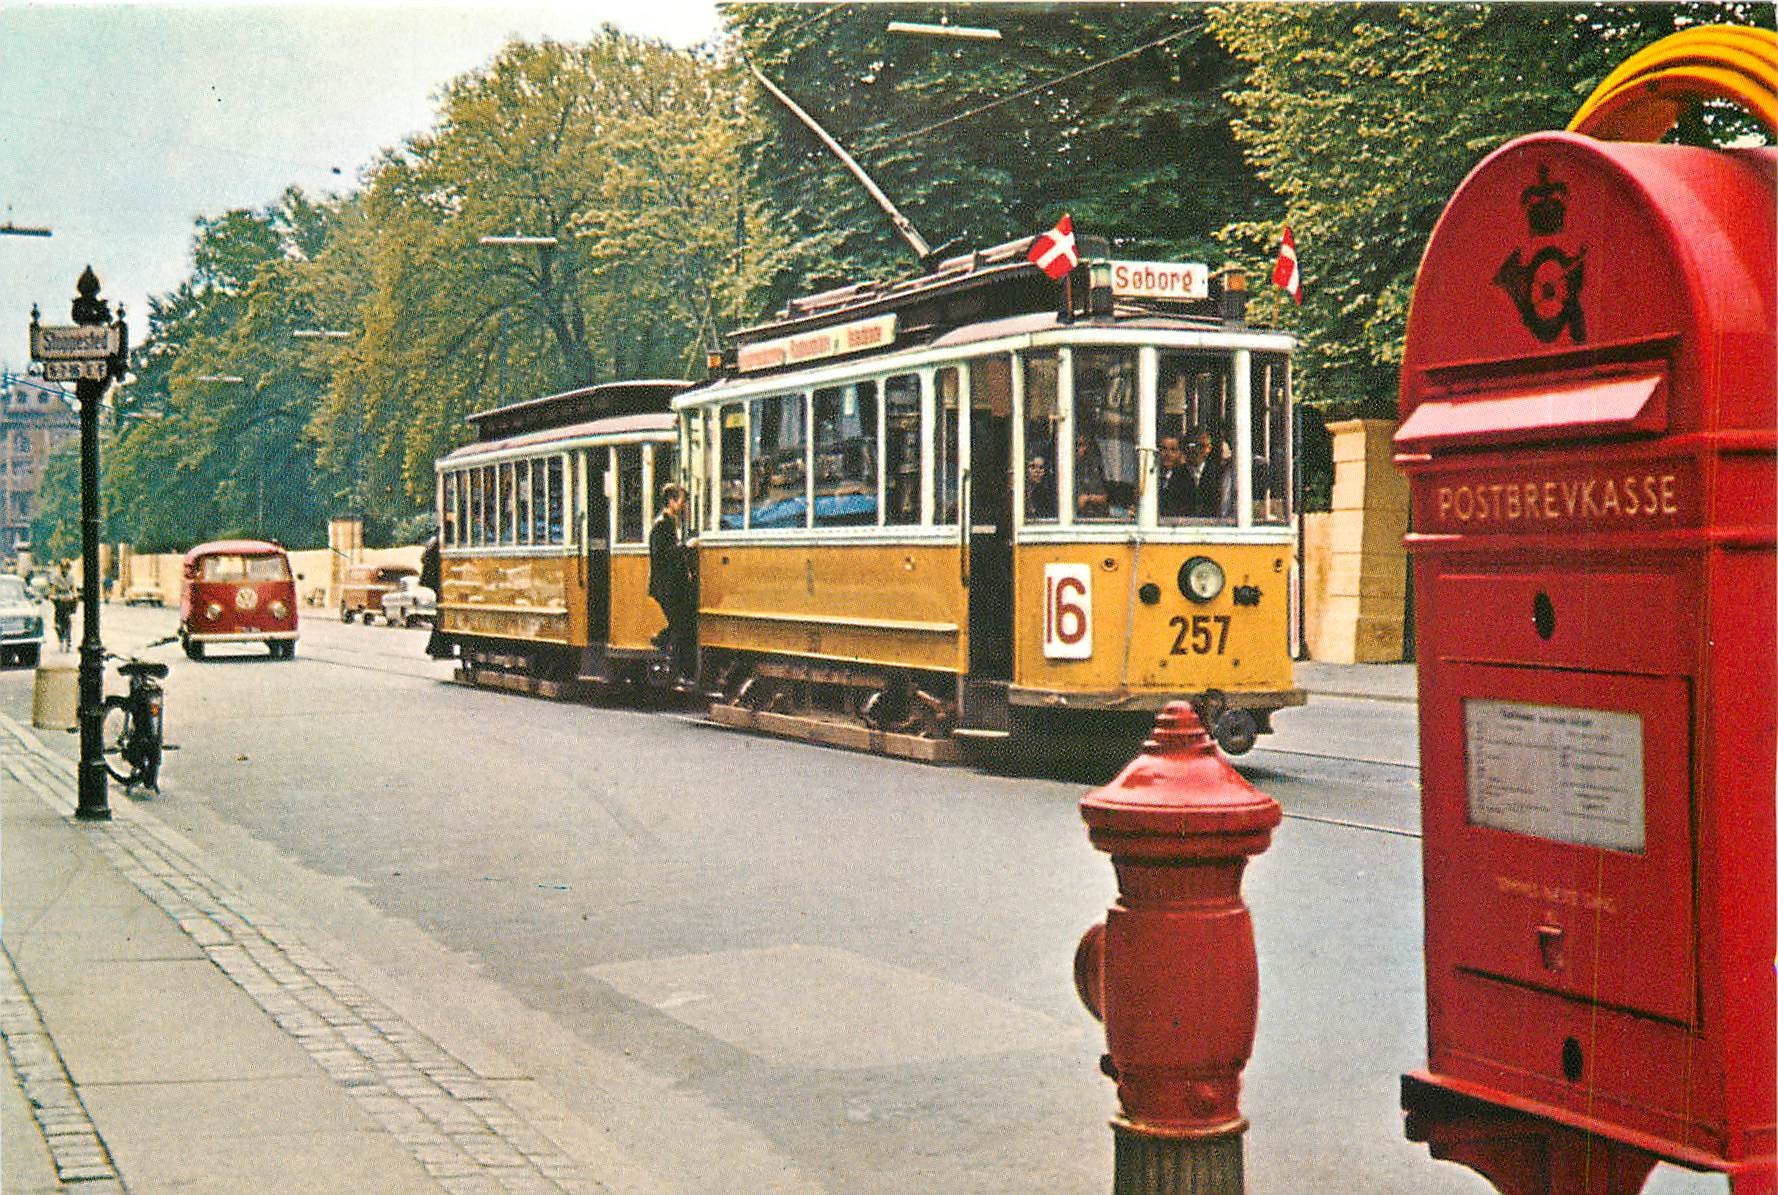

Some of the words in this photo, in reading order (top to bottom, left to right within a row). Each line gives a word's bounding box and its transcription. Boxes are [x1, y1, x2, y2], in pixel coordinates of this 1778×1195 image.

[1116, 266, 1193, 293] Søborg
[1438, 475, 1678, 521] POSTBREVKASSE
[1047, 576, 1087, 645] 16
[1169, 615, 1232, 656] 257
